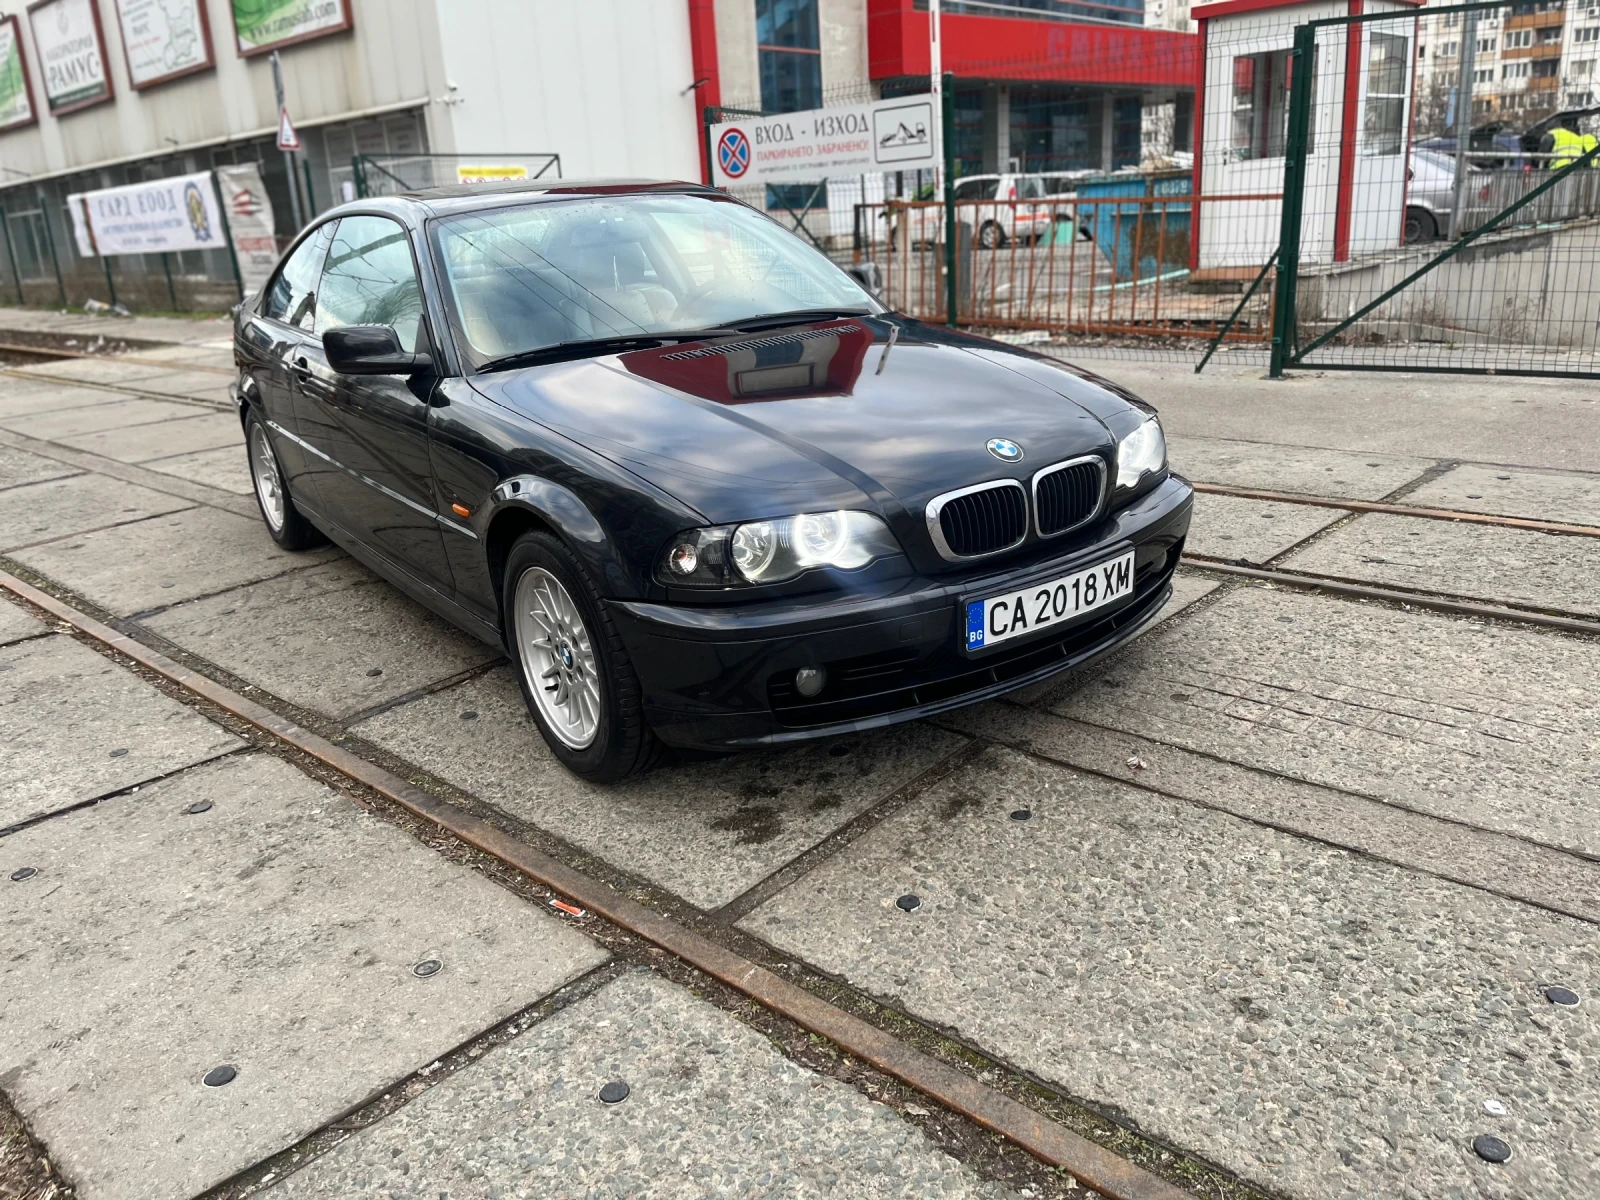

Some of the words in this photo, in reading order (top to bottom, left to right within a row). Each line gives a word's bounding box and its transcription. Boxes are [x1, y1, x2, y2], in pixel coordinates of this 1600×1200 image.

[755, 123, 795, 145] ВХОД
[814, 113, 869, 138] ИЗХОД
[757, 146, 813, 161] ПАРКИРАНЕТО
[816, 139, 870, 156] ЗАБРАНЕНО!
[98, 195, 134, 218] ГАРД
[139, 188, 178, 216] ЕООД
[989, 595, 1029, 636] CA
[1034, 572, 1098, 625] 2018
[1102, 557, 1131, 601] XM
[969, 629, 983, 643] BG
